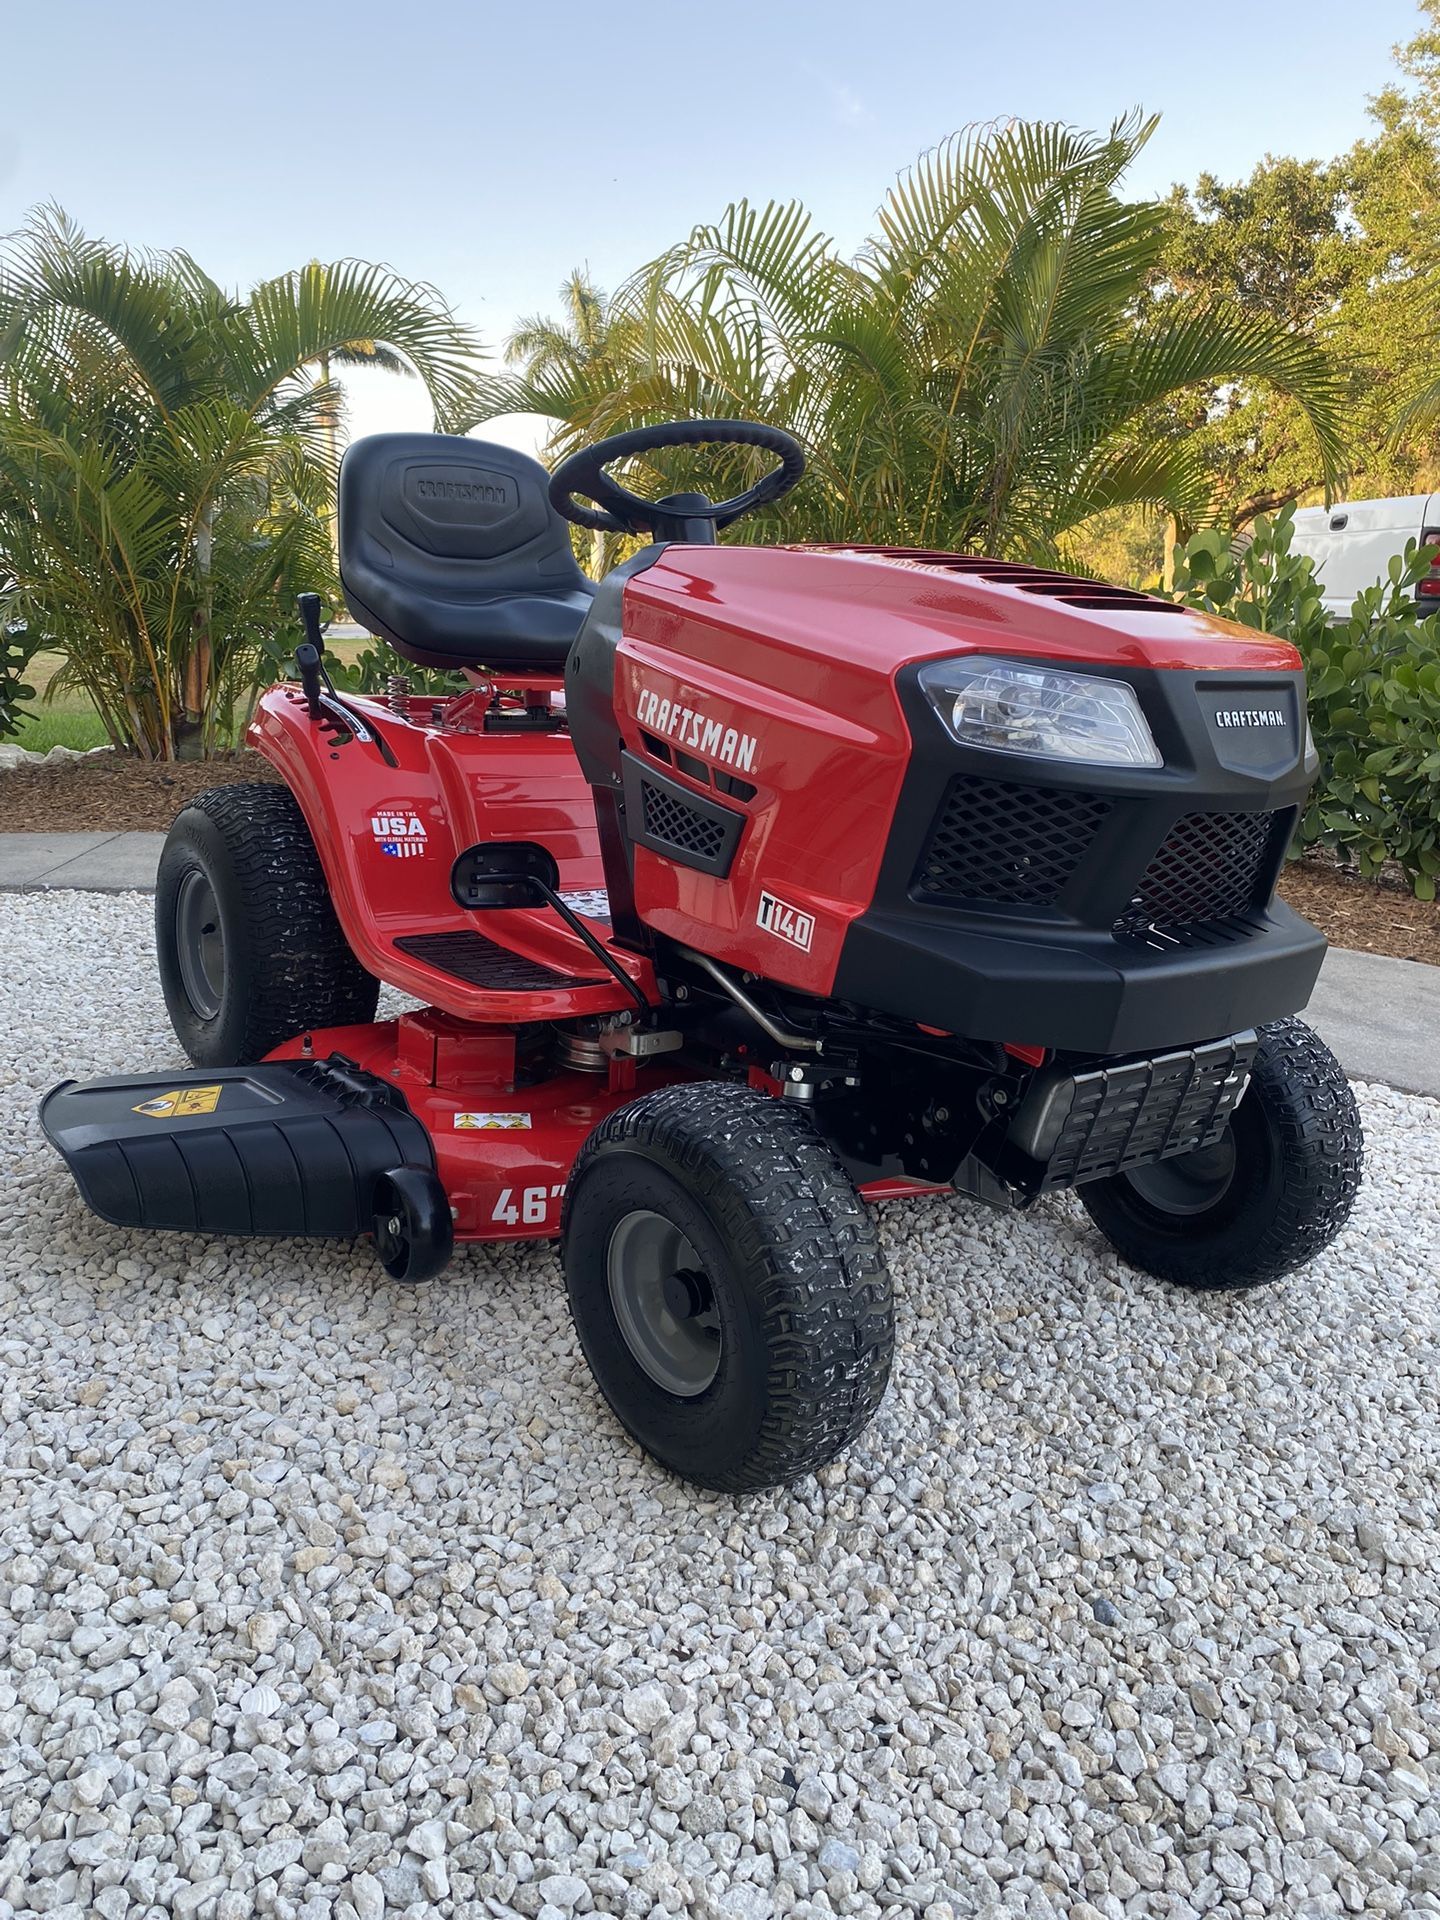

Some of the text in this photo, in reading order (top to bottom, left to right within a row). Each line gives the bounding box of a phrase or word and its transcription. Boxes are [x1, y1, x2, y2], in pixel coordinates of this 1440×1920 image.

[417, 480, 506, 504] CRAFTSMAN
[371, 817, 427, 836] USA
[762, 895, 811, 946] T140
